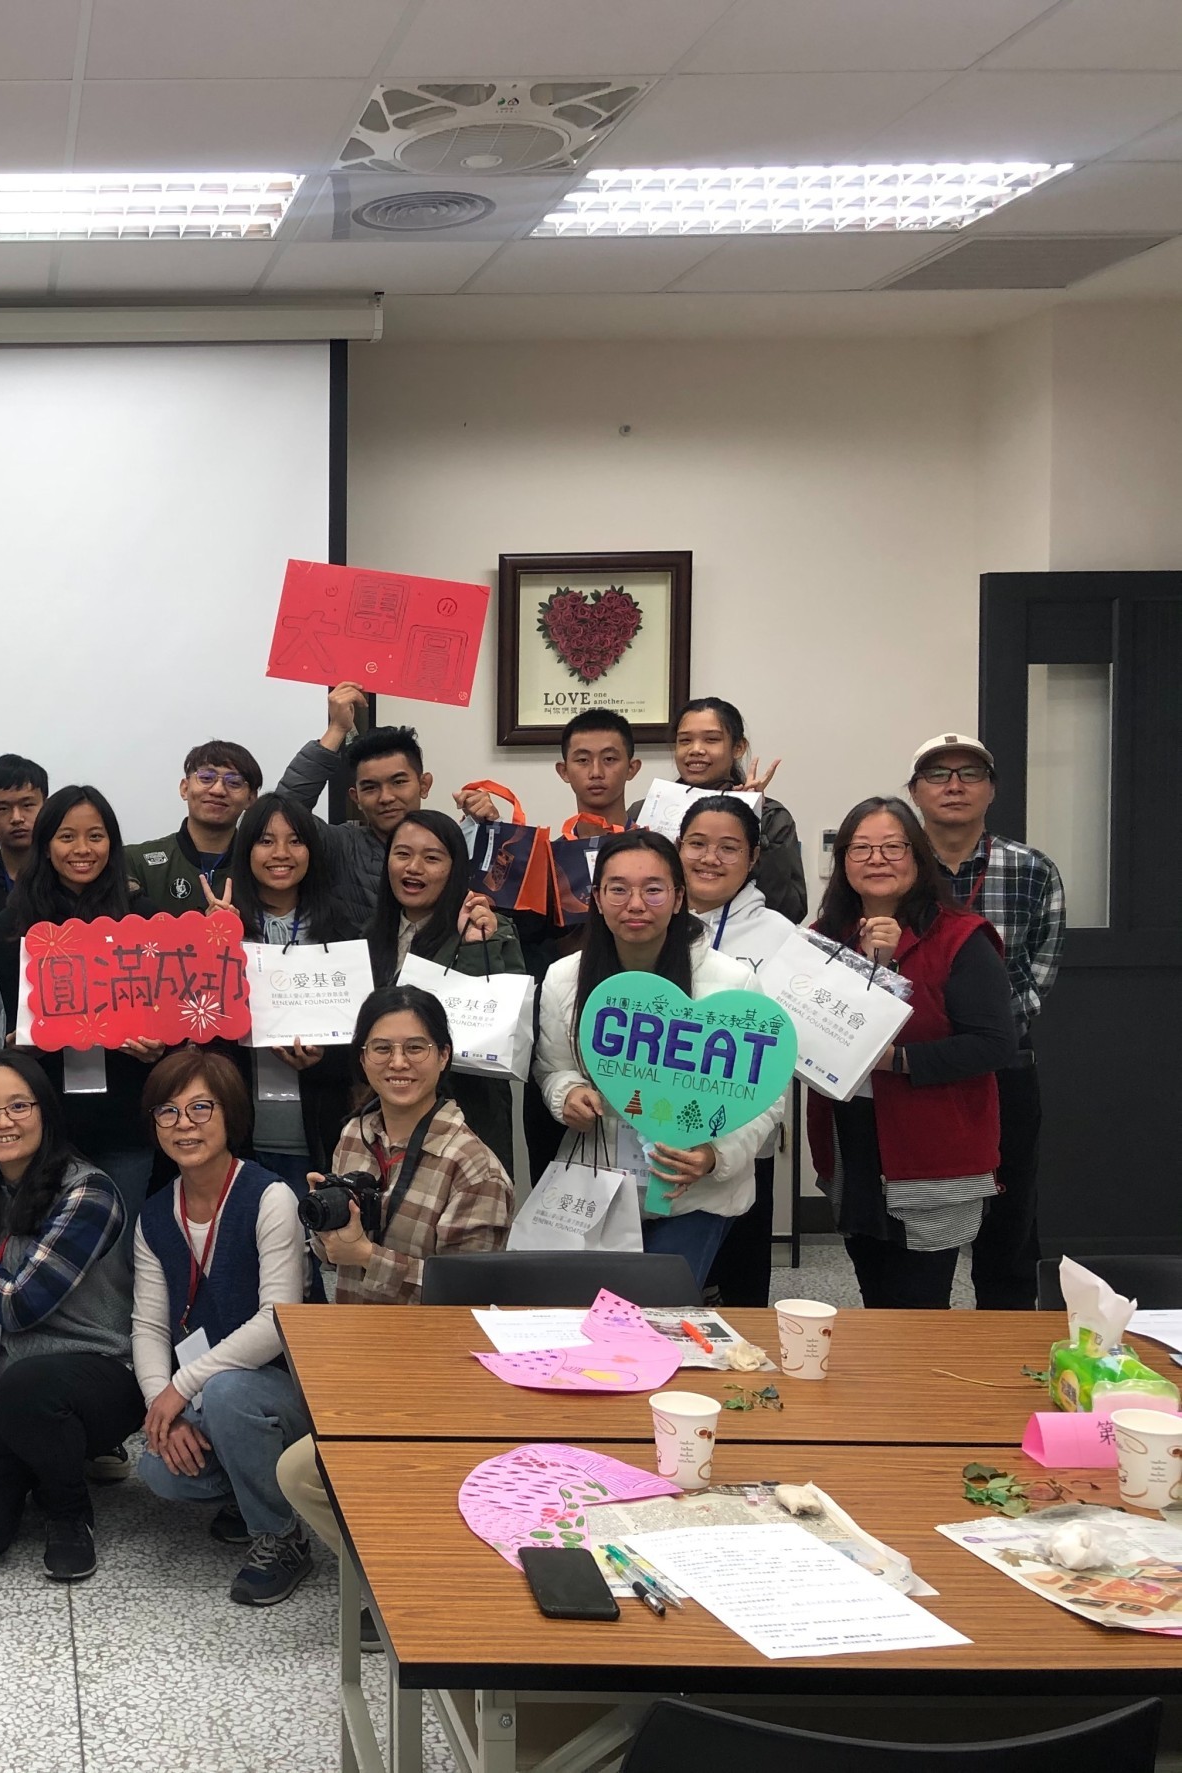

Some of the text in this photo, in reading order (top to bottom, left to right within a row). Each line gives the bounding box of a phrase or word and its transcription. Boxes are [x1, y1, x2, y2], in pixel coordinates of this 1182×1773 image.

[543, 692, 591, 706] LOVE
[38, 944, 244, 1018] 圓滿成功
[292, 970, 348, 989] 愛基會
[304, 998, 351, 1006] FOUNDATION
[444, 997, 499, 1014] 愛基會
[605, 994, 786, 1036] 財團法人愛心第二春文教基金會
[810, 988, 868, 1031] 愛基會
[776, 995, 851, 1047] RENEWAL FOUNDATION
[592, 1007, 778, 1084] GREAT
[597, 1058, 757, 1101] RENEWAL FOUDATION
[556, 1193, 597, 1219] 愛基會
[1096, 1420, 1117, 1446] 第
